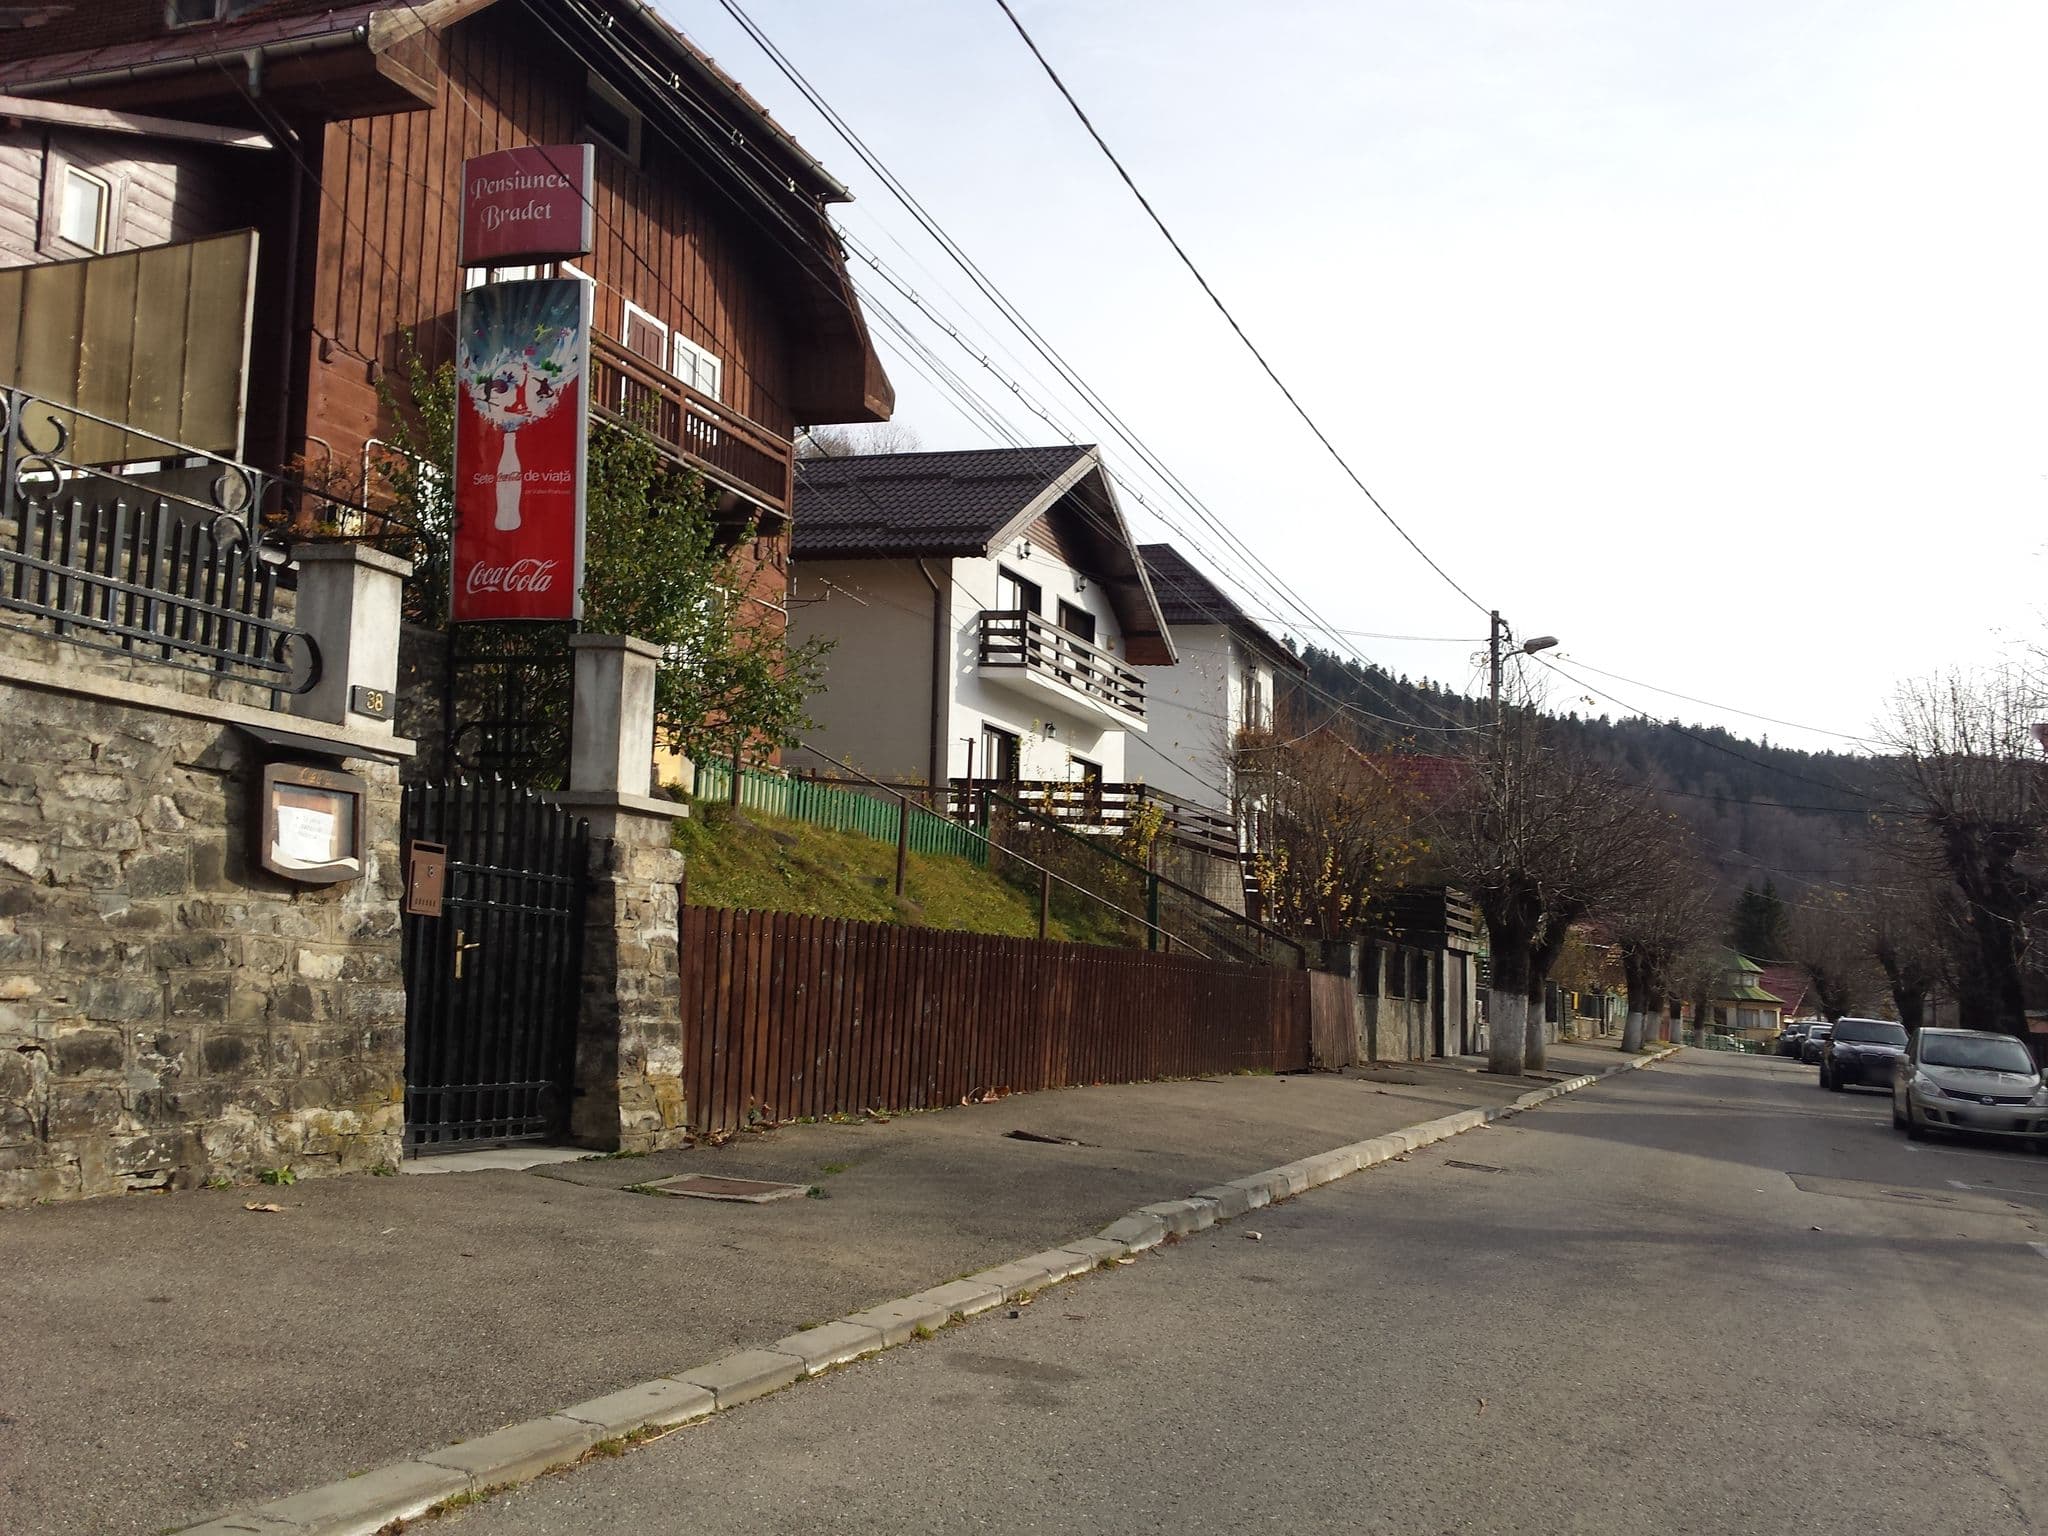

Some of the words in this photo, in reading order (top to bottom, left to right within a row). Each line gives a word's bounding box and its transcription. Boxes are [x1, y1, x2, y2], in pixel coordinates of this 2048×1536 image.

[471, 171, 570, 201] Pensiunea
[481, 200, 552, 231] Bradet
[473, 472, 495, 486] Sete
[524, 470, 539, 482] de
[366, 690, 384, 712] 38
